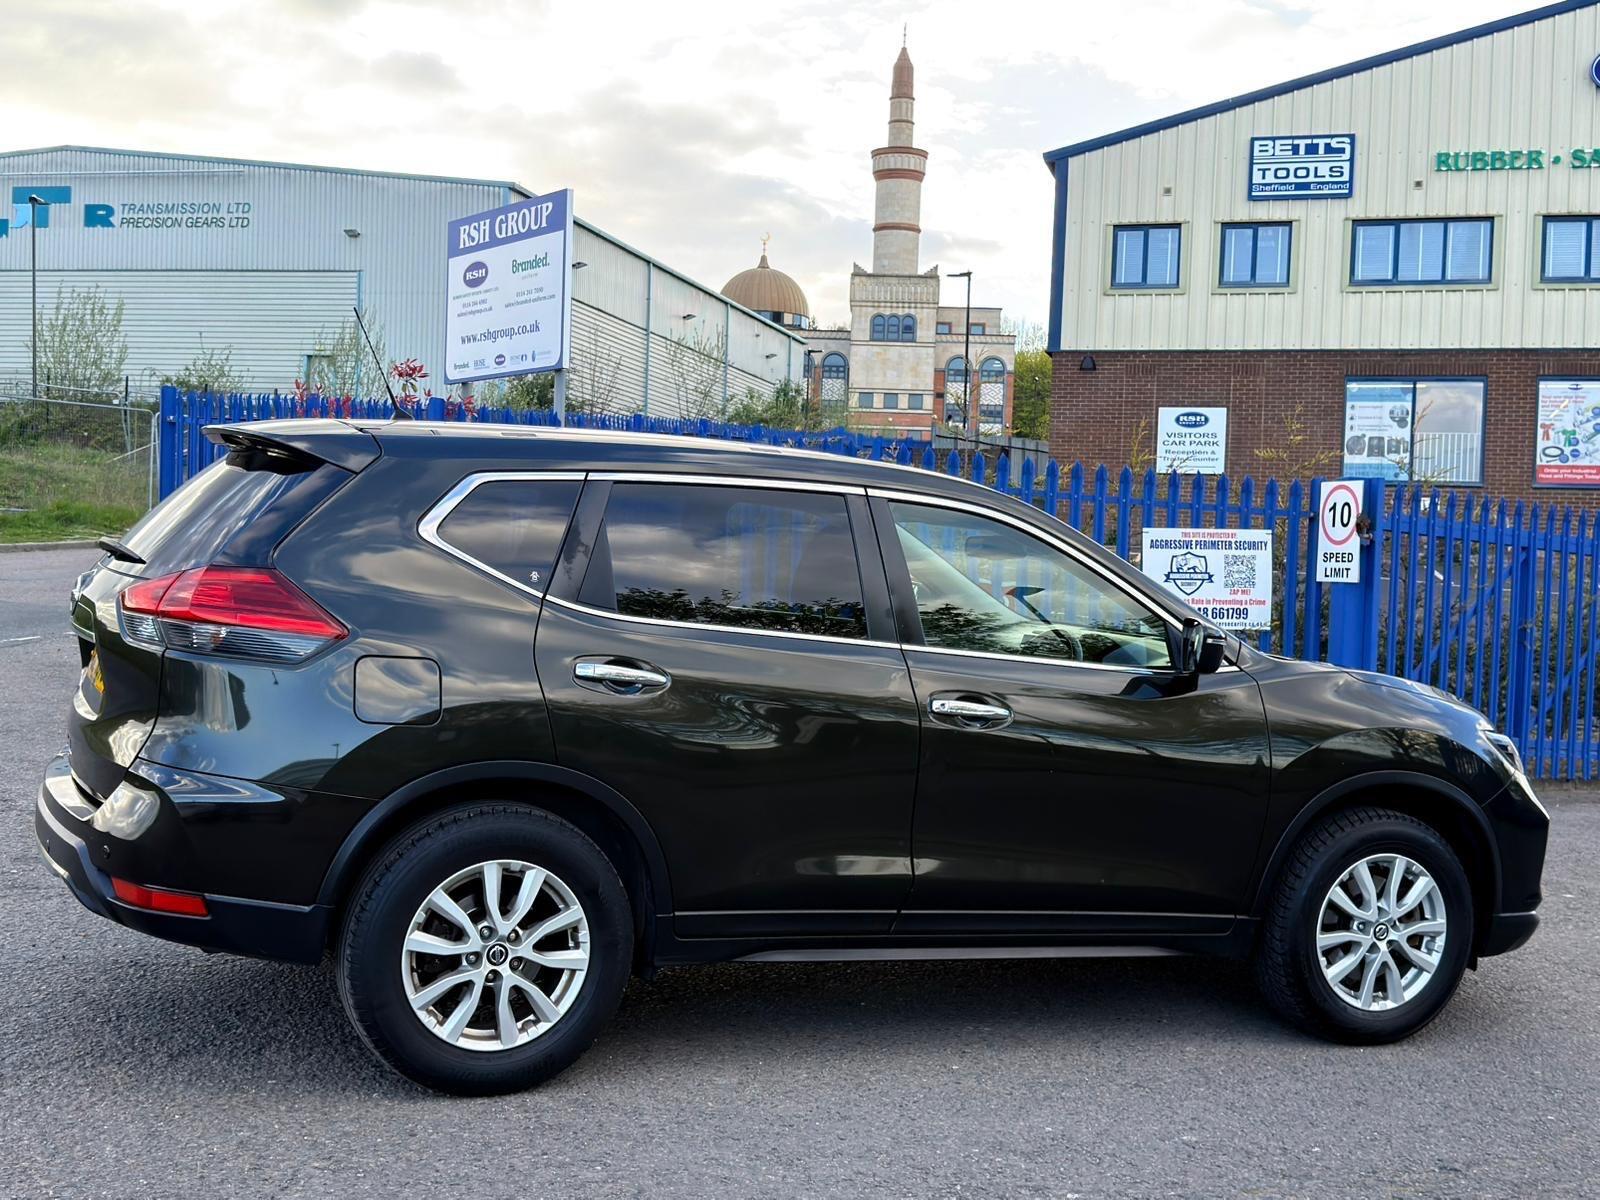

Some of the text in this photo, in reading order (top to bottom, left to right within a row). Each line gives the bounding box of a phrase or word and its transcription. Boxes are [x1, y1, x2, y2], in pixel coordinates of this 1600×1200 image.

[1253, 137, 1351, 160] BETTS
[1435, 150, 1545, 171] RUBBER
[1257, 166, 1344, 180] TOOLS
[1252, 183, 1350, 192] Sheffield England
[120, 202, 252, 215] TRANSMISSION LTD
[119, 217, 250, 229] PRECISION GEARS LTD
[459, 201, 553, 249] RSH GROUP
[512, 252, 550, 274] Branded.
[465, 268, 487, 281] RSH
[461, 320, 541, 345] www.rshgroup.co.uk
[1328, 501, 1352, 528] 10
[1149, 539, 1268, 551] AGGRESSIVE PERIMETER SECURITY
[1322, 552, 1354, 563] SPEED
[1324, 567, 1351, 578] LIMIT
[1212, 598, 1244, 606] Preventing
[1211, 607, 1249, 620] 661799
